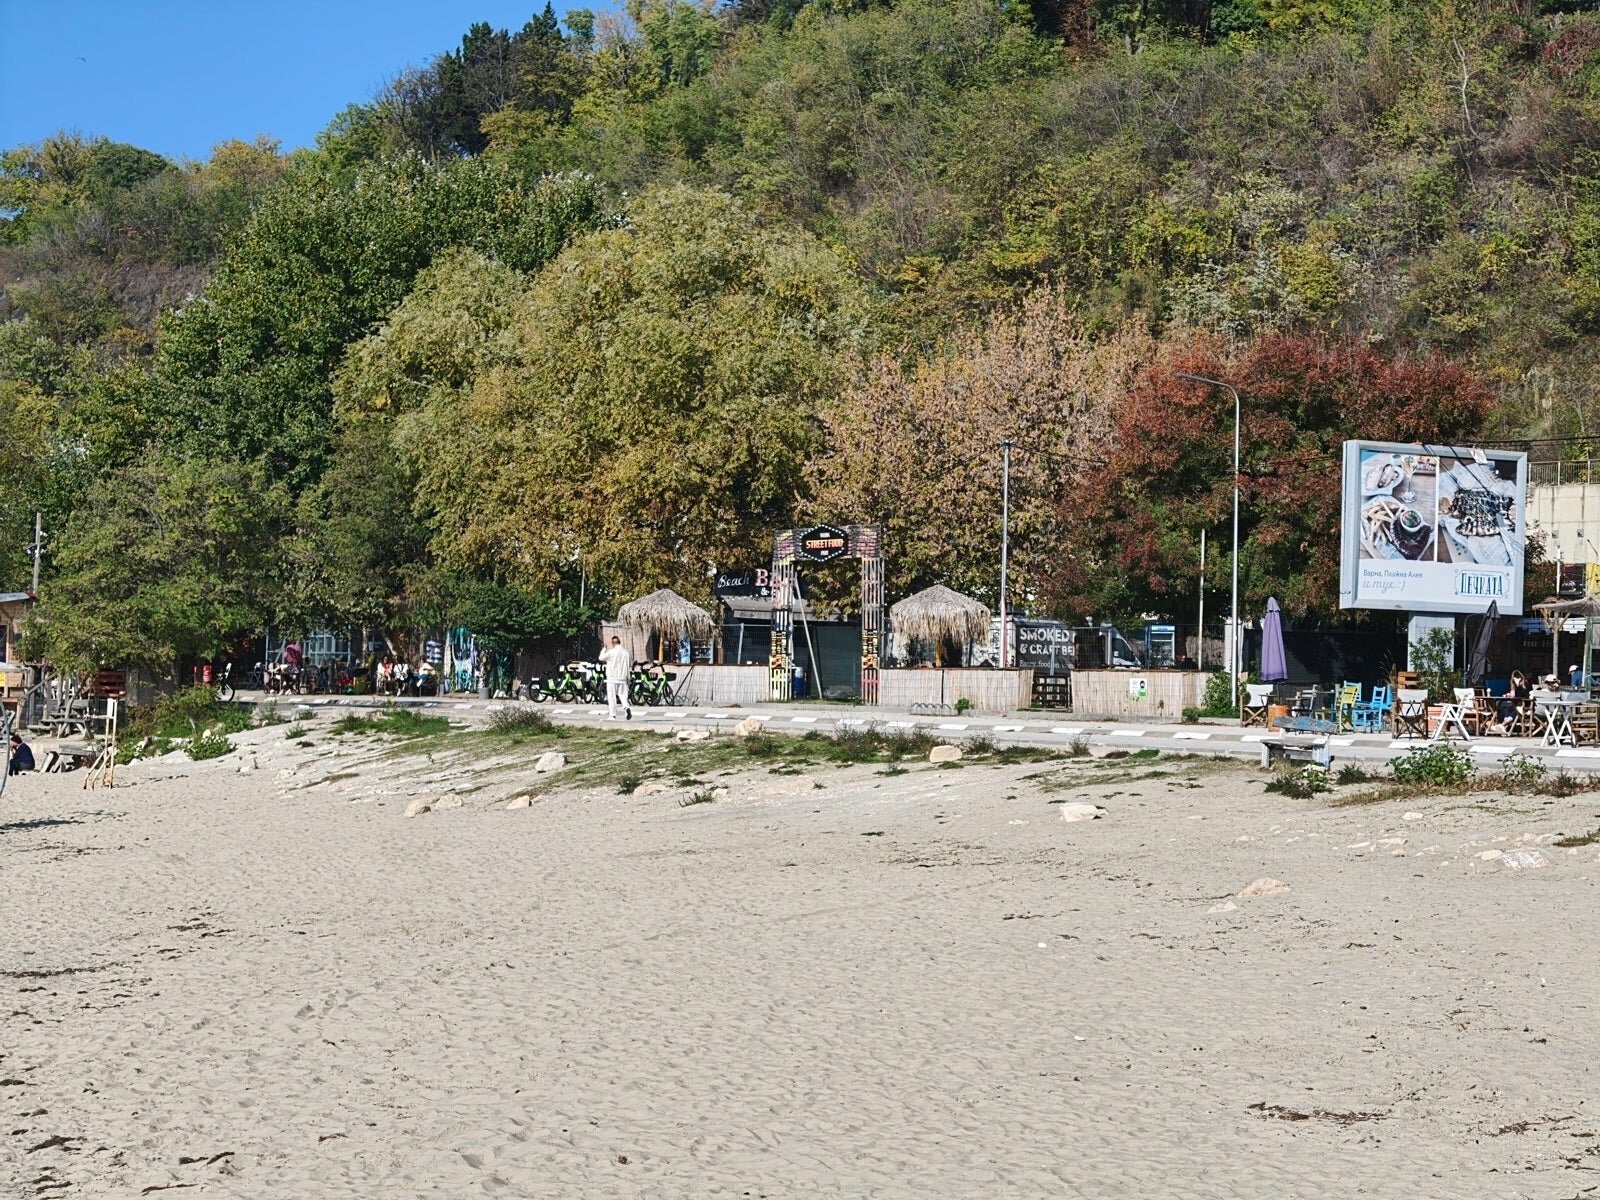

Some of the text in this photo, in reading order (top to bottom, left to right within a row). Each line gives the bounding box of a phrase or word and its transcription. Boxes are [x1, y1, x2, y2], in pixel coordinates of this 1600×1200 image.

[805, 538, 844, 549] STREET FOOD
[717, 571, 750, 589] Beach
[1363, 569, 1423, 579] Варна, Плажна Алея
[1019, 627, 1070, 642] SMOKED
[1019, 643, 1075, 656] & CRAFT BE
